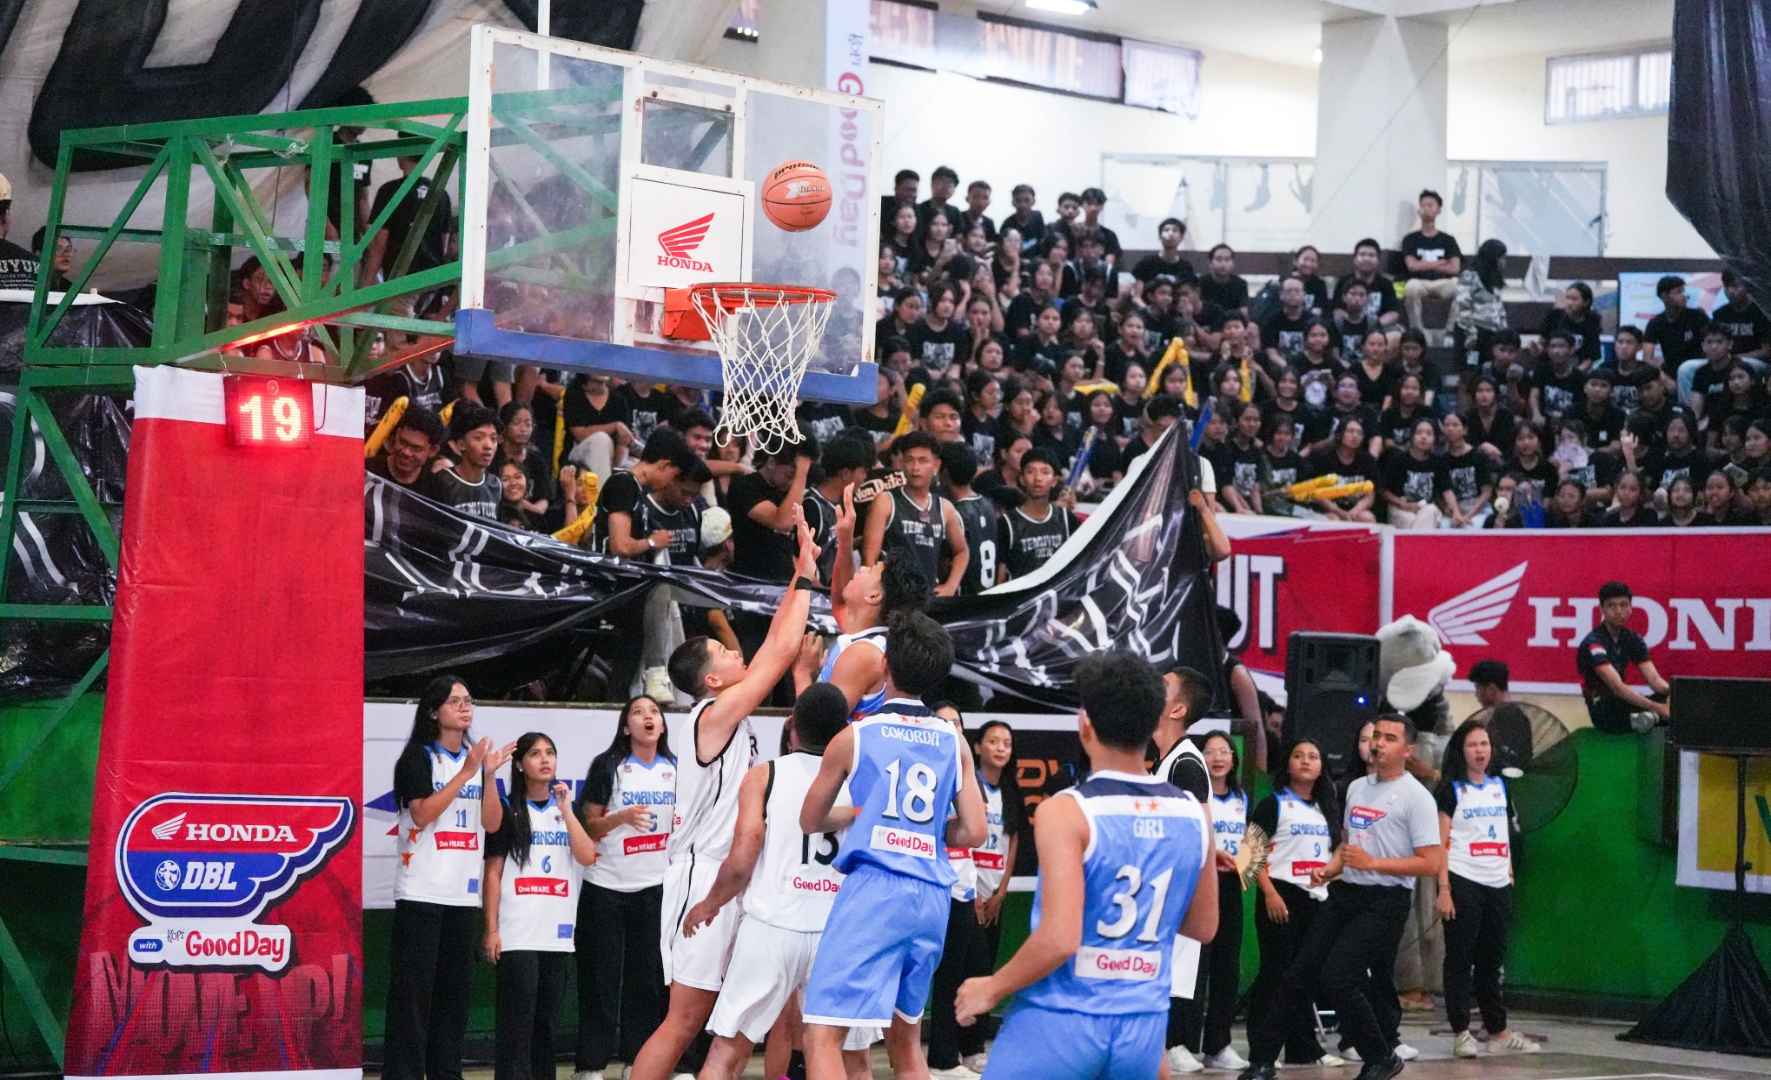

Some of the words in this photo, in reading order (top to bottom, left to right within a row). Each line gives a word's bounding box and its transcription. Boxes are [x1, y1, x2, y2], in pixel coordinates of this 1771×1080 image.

[657, 256, 714, 272] HONDA
[239, 395, 302, 441] 19
[979, 540, 996, 588] 8
[881, 725, 939, 747] COKORDA
[881, 758, 938, 825] 18
[456, 809, 467, 828] 11
[1133, 818, 1165, 839] GIRI
[185, 823, 297, 842] HONDA
[1488, 825, 1497, 839] 4
[1314, 842, 1321, 857] 9
[541, 855, 552, 874] 6
[180, 862, 237, 890] DBL
[1096, 864, 1174, 944] 31
[139, 941, 157, 949] with
